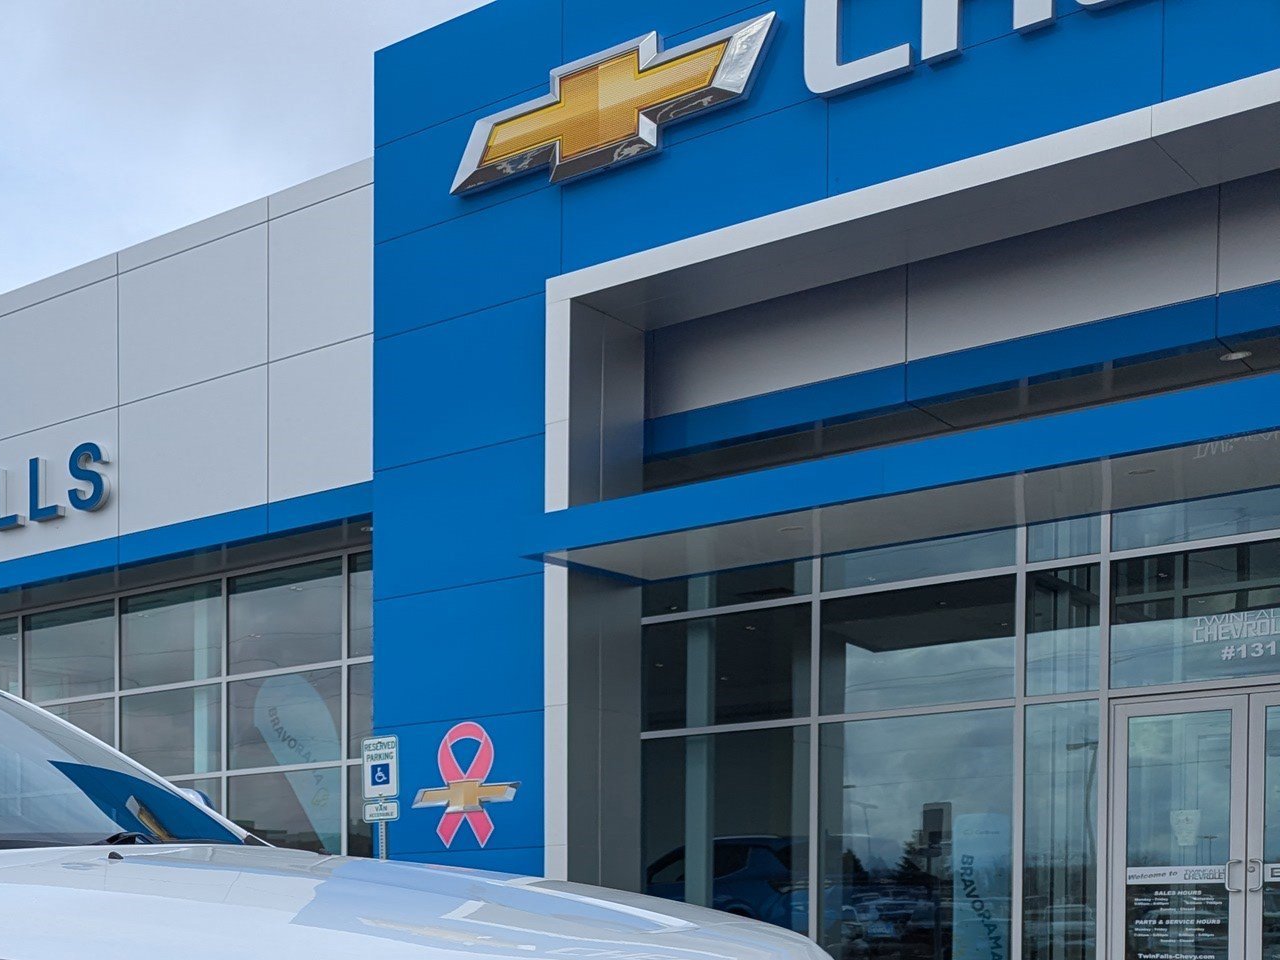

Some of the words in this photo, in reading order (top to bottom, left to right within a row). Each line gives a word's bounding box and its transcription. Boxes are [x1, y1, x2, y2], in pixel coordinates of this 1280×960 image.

[267, 705, 325, 787] BRAVORAA
[364, 740, 395, 751] RESERVED
[366, 751, 394, 762] PARKING
[374, 804, 387, 812] VAN
[1128, 871, 1166, 880] Welcome
